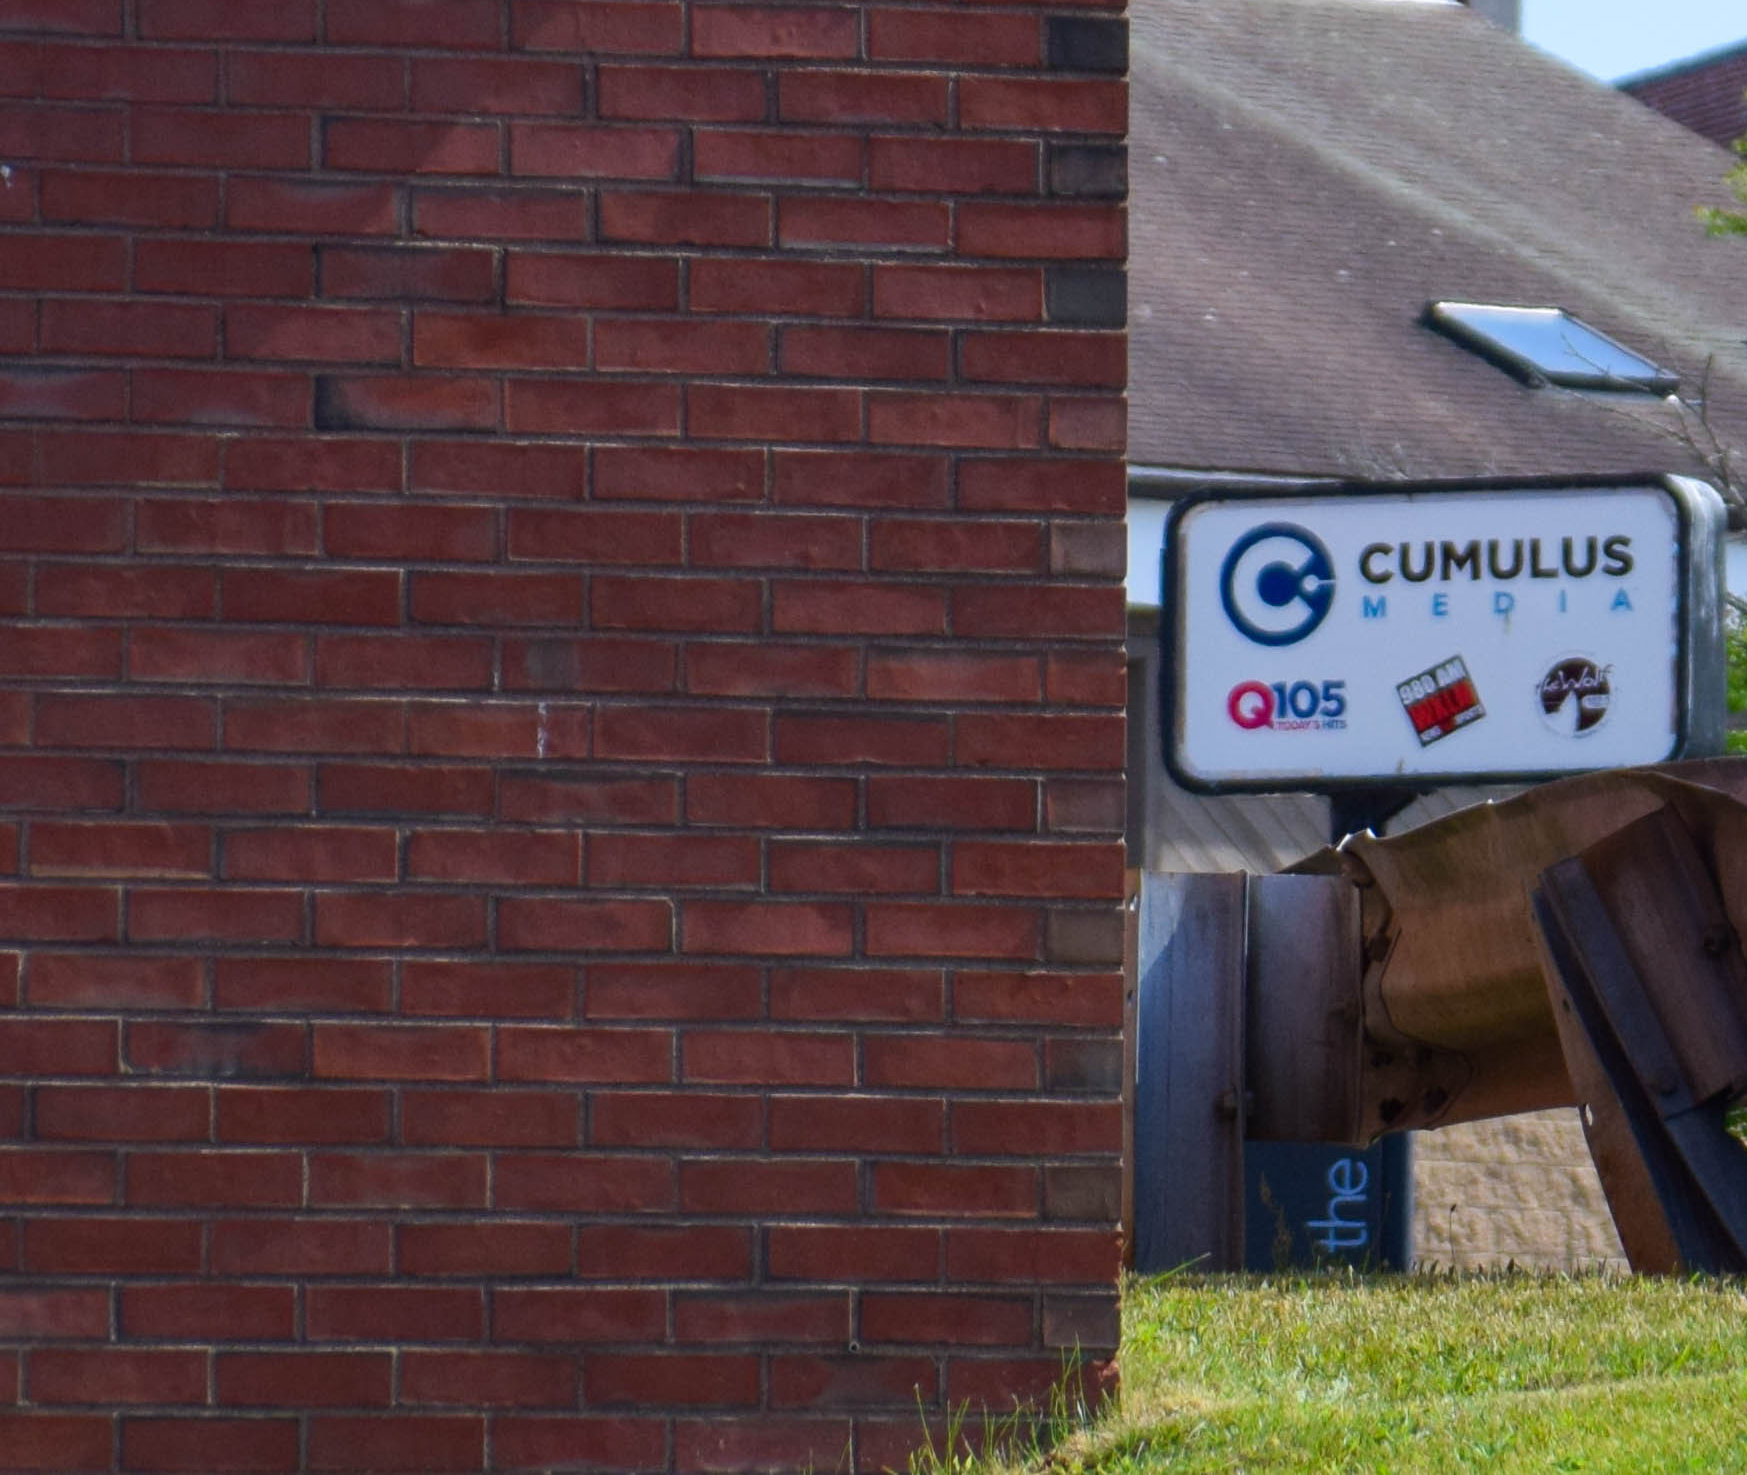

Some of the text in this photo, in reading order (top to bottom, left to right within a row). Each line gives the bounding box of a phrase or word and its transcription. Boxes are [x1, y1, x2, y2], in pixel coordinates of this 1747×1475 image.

[1358, 534, 1634, 585] CUMULUS
[1362, 588, 1633, 619] MEDIA
[1227, 679, 1348, 730] Q105
[1306, 1157, 1368, 1254] the
